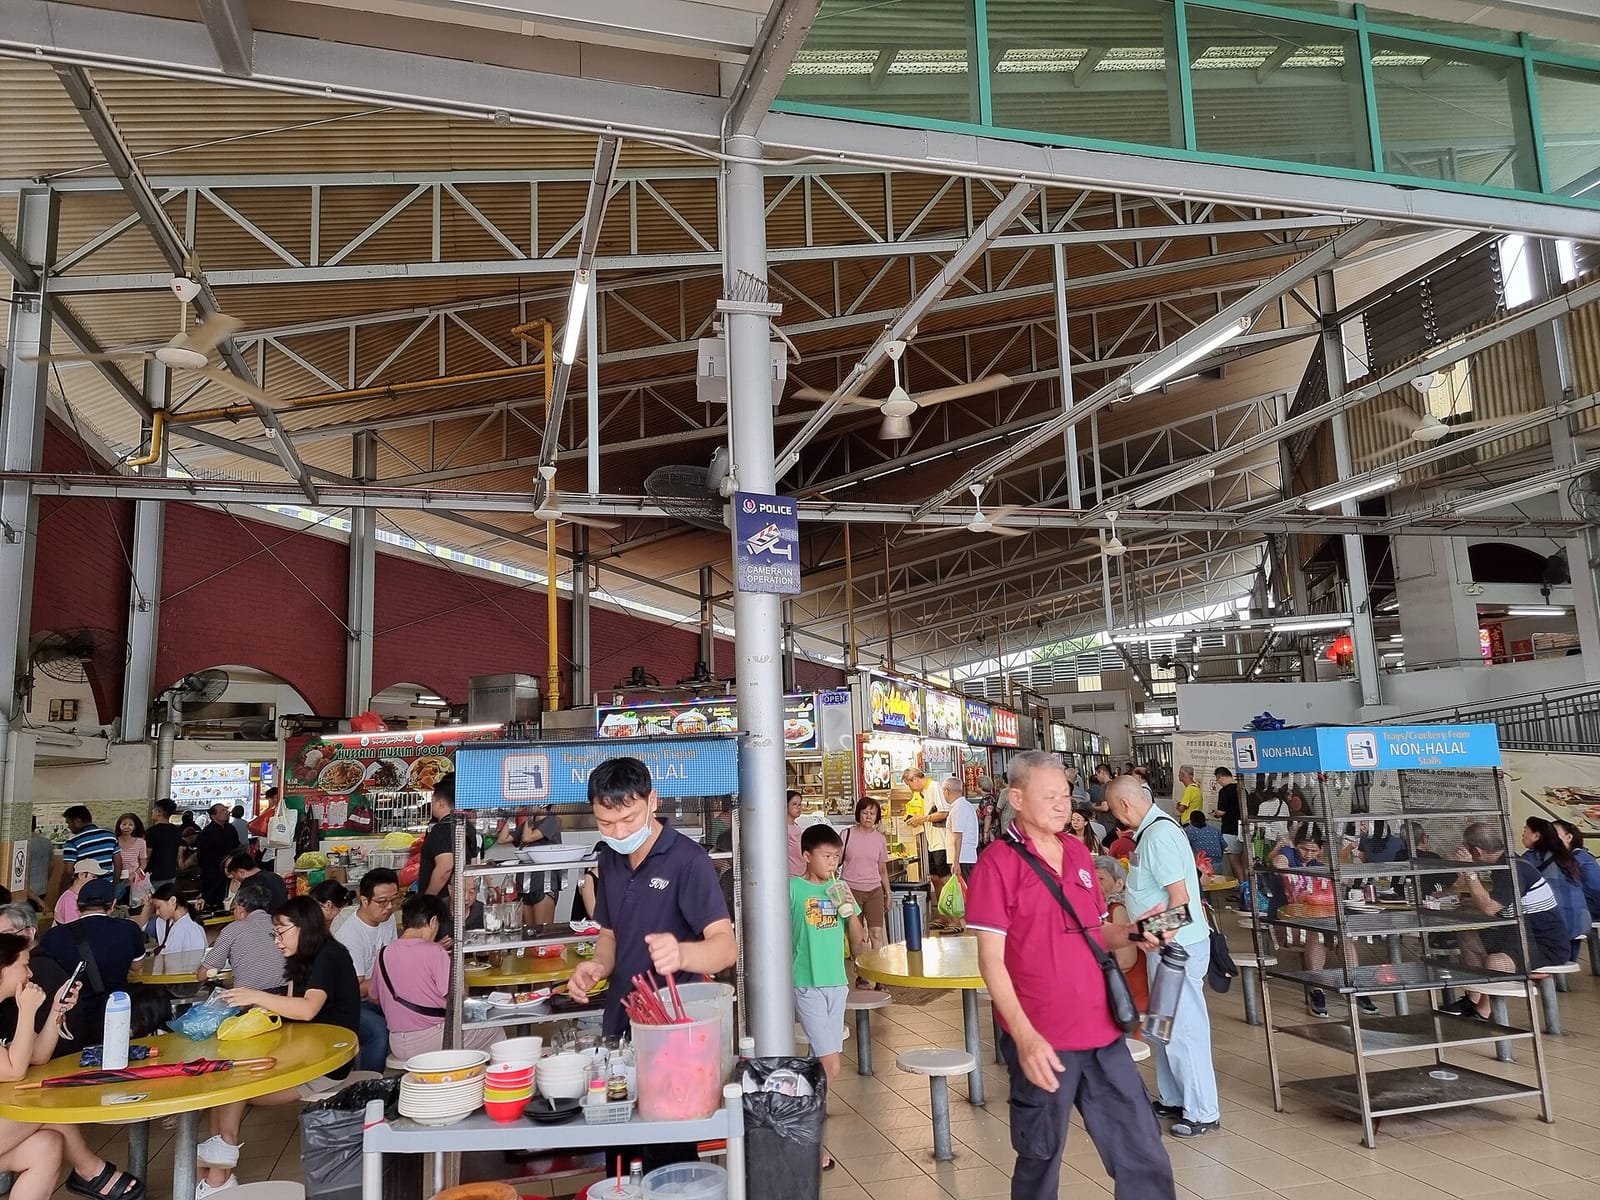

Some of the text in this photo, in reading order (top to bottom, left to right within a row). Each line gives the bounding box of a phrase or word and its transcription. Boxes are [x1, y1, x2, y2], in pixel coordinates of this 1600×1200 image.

[759, 503, 793, 516] POLICE
[746, 565, 793, 576] CAMERA IN
[746, 575, 793, 585] OPERATION
[824, 695, 846, 703] OPEN
[1447, 730, 1470, 739] From
[337, 745, 446, 760] HUSSAIN MUSLIM FOOD
[1262, 746, 1315, 758] NON-HALAL
[1389, 741, 1468, 756] NON-HALAL
[1418, 756, 1441, 765] Stalls
